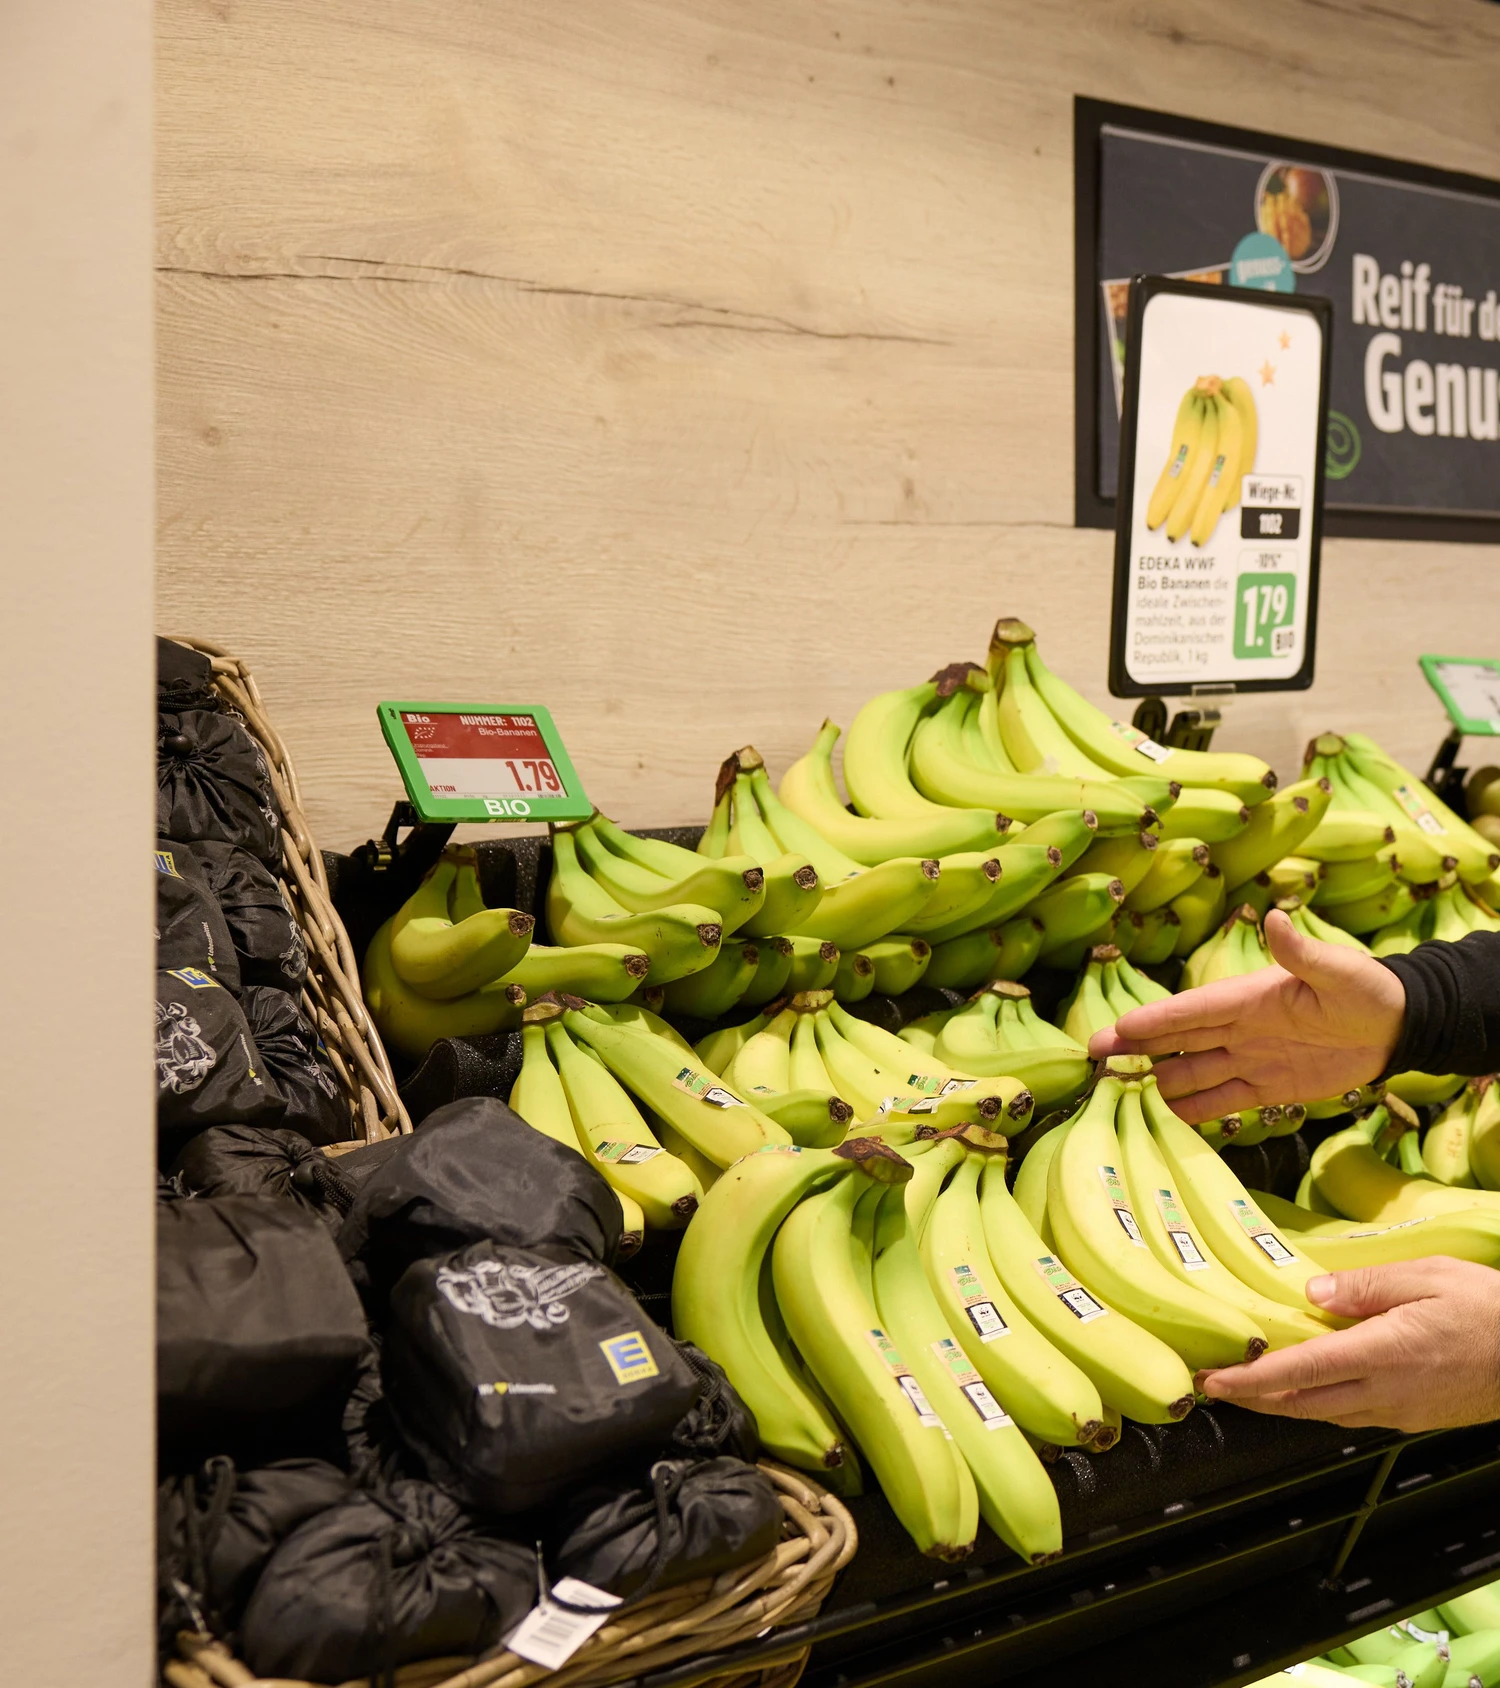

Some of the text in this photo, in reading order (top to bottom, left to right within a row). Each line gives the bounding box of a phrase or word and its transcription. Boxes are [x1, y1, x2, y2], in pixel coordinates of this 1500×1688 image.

[1352, 253, 1430, 332] Reif
[1432, 283, 1475, 338] für
[1259, 513, 1283, 534] 1102
[1139, 556, 1216, 571] EDEKA WWF
[1137, 576, 1157, 590] Bio
[1160, 577, 1211, 589] Bananen
[1135, 595, 1225, 609] ideale Zwischen-
[1135, 613, 1227, 629] mahlzeit, aus der
[1133, 632, 1225, 646] Dominikanischen
[1276, 631, 1295, 651] BIO
[1133, 650, 1185, 665] Republik,
[1195, 649, 1210, 665] kg
[406, 714, 431, 723] Bio
[459, 714, 535, 727] NUMMER: 1102
[477, 727, 538, 737] Bio-Bananen
[504, 760, 561, 792] 1.79
[429, 784, 457, 793] AKTION
[483, 799, 531, 816] BIO
[608, 1338, 649, 1370] E
